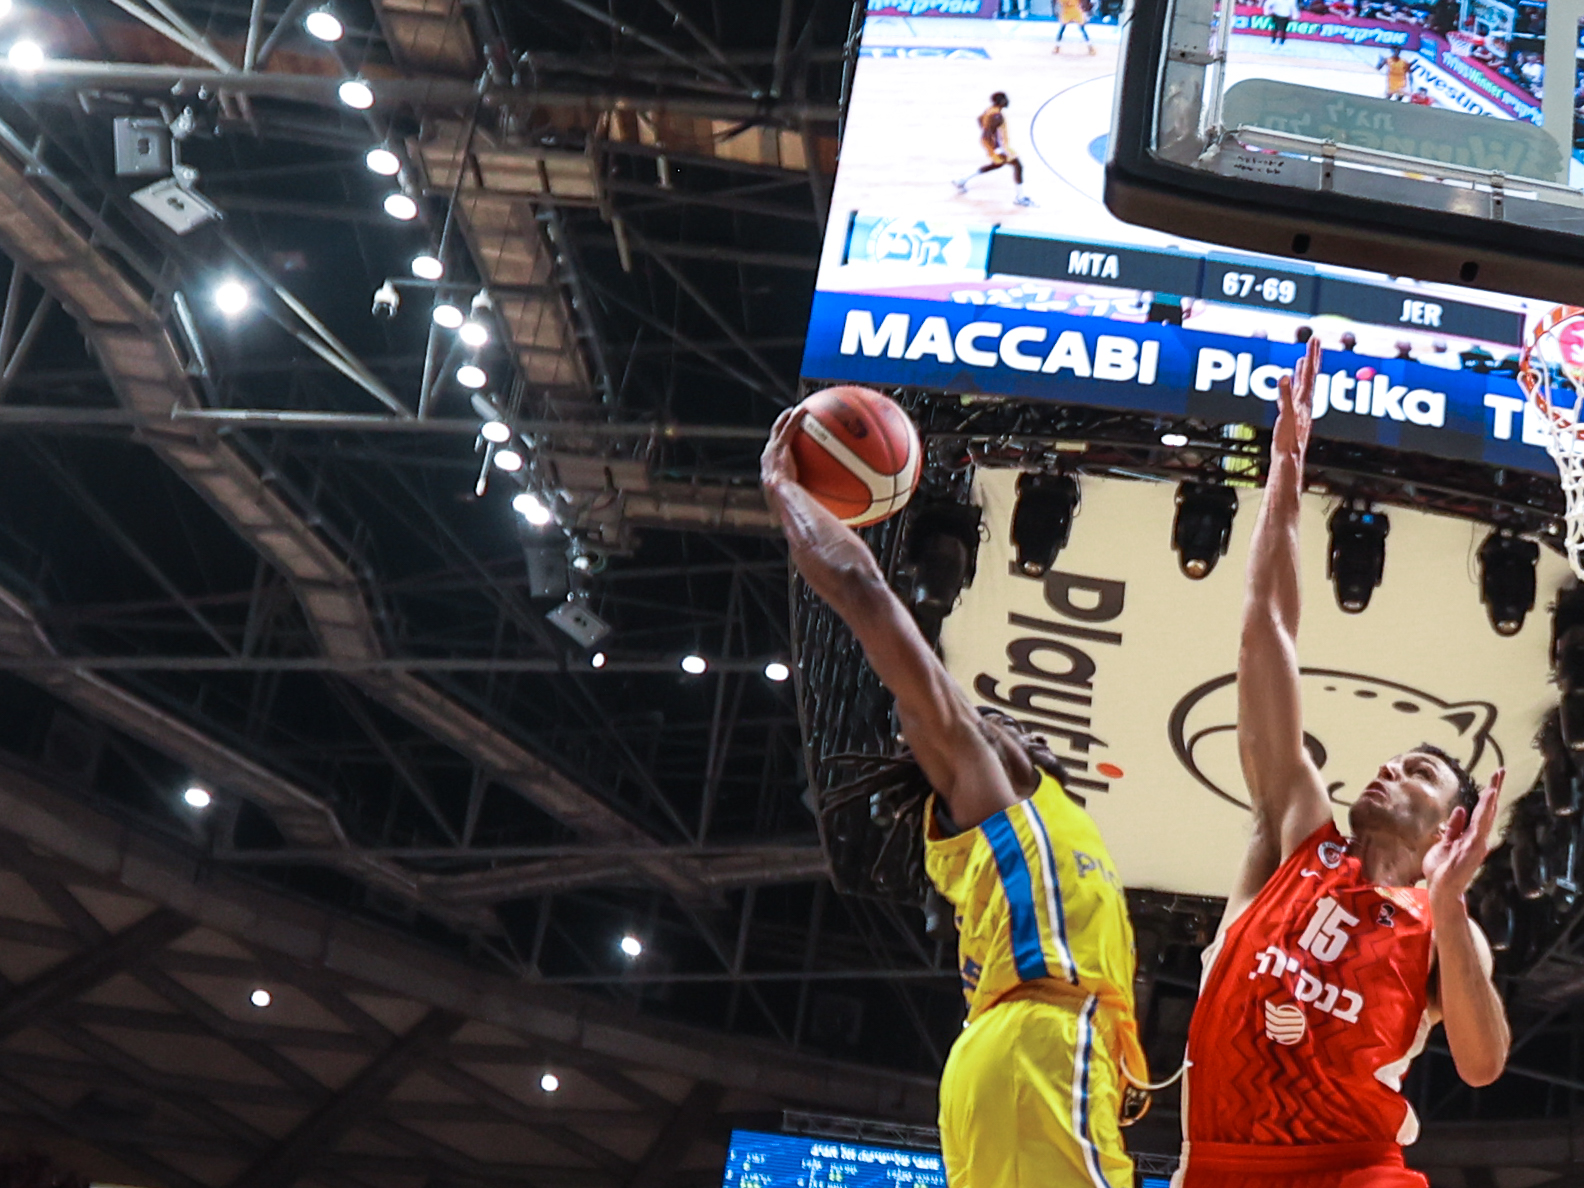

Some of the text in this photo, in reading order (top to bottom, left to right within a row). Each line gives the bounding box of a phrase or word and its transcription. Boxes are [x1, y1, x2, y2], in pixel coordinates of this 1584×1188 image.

[1409, 58, 1495, 117] Investin
[1067, 249, 1120, 280] MTA
[1400, 299, 1444, 328] JER
[840, 309, 1160, 386] MACCABI
[1297, 896, 1360, 963] 15
